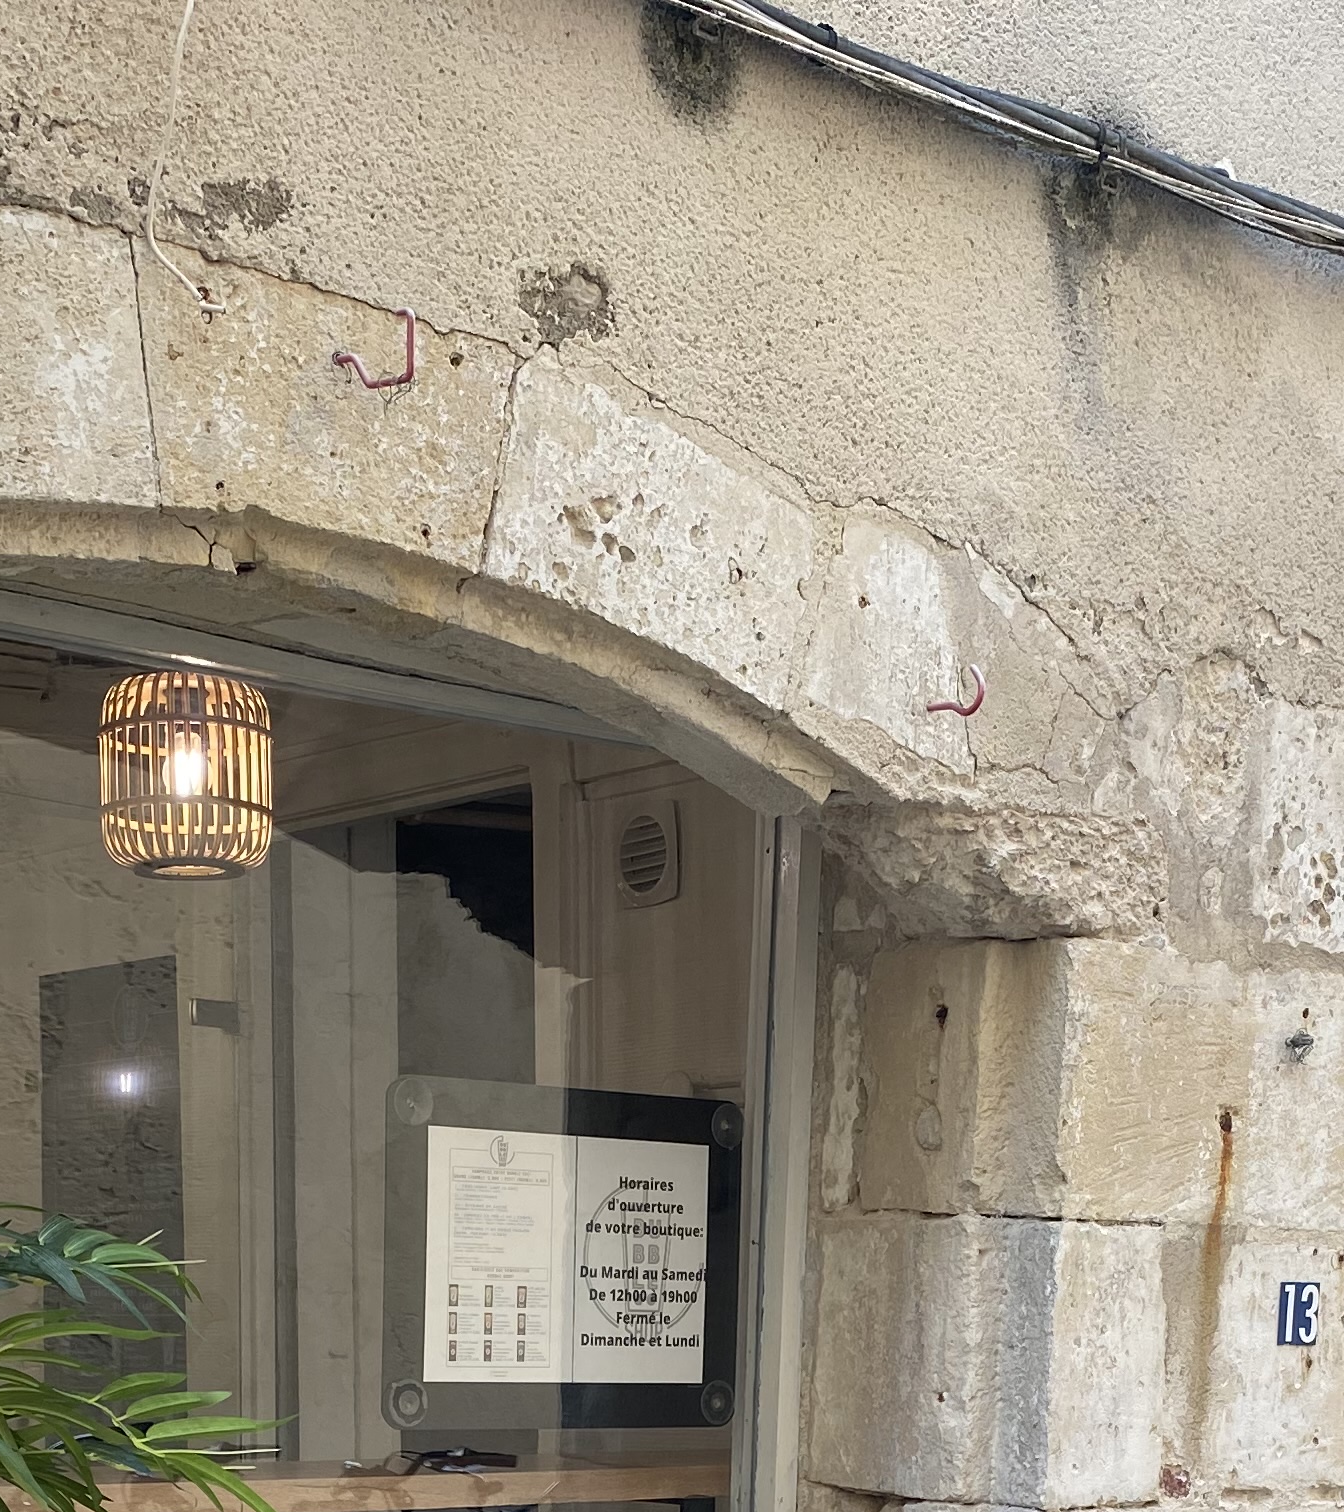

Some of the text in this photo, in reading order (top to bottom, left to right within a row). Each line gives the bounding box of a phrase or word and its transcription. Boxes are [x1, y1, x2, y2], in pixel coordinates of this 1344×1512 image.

[619, 1176, 674, 1191] Horaires
[608, 1197, 684, 1214] d'ouverture
[586, 1219, 704, 1240] de votre boutique:
[580, 1265, 707, 1282] Du Mardi au Samedi
[589, 1288, 698, 1303] De 12h00 à 19h00
[616, 1312, 671, 1325] Fermé le
[1285, 1284, 1319, 1343] 13
[581, 1333, 700, 1347] Dimanche et Lundi
